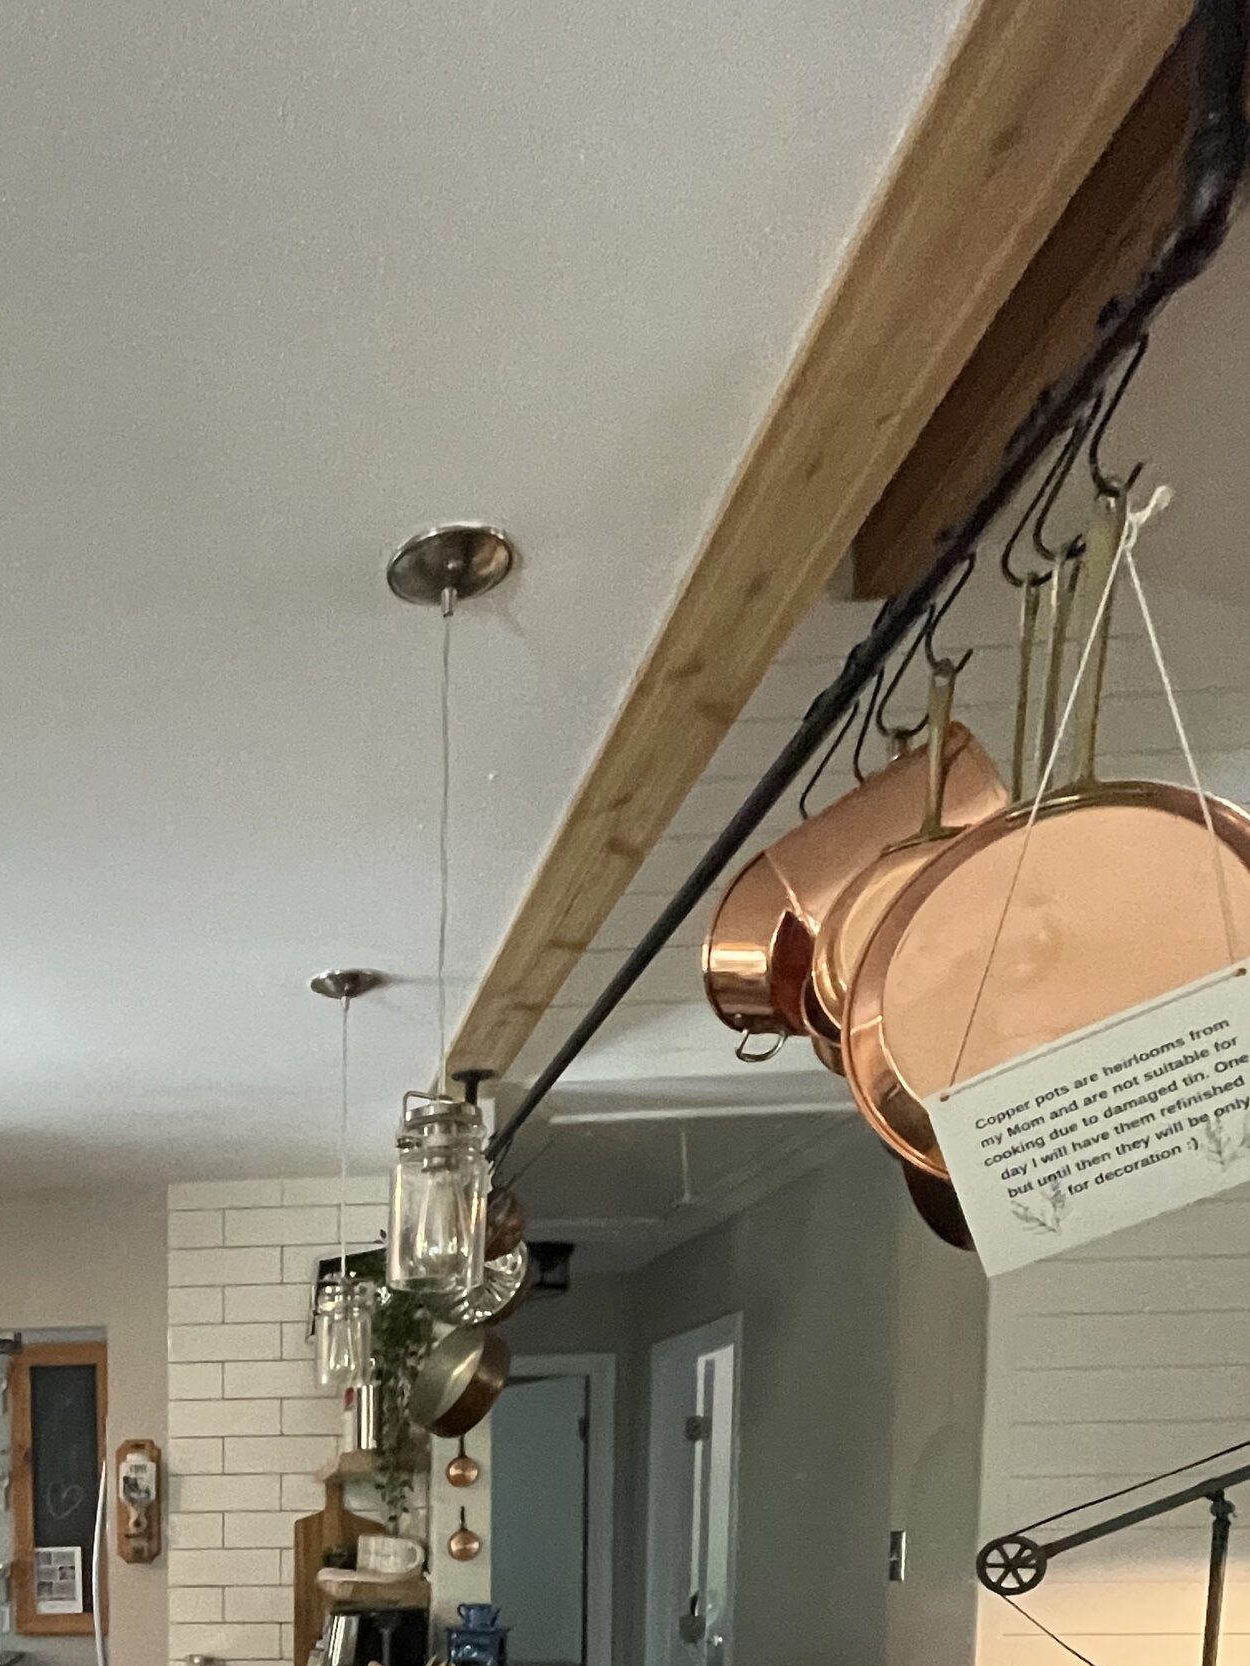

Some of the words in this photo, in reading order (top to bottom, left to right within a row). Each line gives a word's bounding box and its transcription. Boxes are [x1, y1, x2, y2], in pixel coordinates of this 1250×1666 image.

[975, 1100, 1030, 1129] Copper
[1035, 1085, 1069, 1107] pots
[1074, 1073, 1099, 1089] are
[1102, 1038, 1185, 1076] heirlooms
[1189, 1020, 1229, 1040] from
[981, 1133, 1002, 1148] my
[1007, 1116, 1045, 1137] Mom
[1050, 1100, 1079, 1120] and
[1083, 1090, 1108, 1106] are
[1112, 1076, 1139, 1094] not
[1144, 1049, 1210, 1082] suitable
[1214, 1037, 1237, 1052] for
[984, 1136, 1046, 1167] cooking
[1049, 1123, 1078, 1140] due
[1082, 1115, 1099, 1127] to
[1103, 1080, 1178, 1119] damaged
[1182, 1072, 1210, 1087] tin.
[1214, 1054, 1249, 1073] One
[1001, 1163, 1027, 1180] day
[1040, 1145, 1068, 1163] will
[1072, 1131, 1110, 1152] have
[1114, 1113, 1156, 1135] them
[1160, 1075, 1245, 1117] refinished
[1007, 1181, 1034, 1198] but
[1037, 1164, 1071, 1187] until
[1075, 1152, 1111, 1171] then
[1115, 1136, 1150, 1155] they
[1155, 1120, 1184, 1140] will
[1188, 1113, 1209, 1127] be
[1214, 1096, 1250, 1117] only
[1068, 1180, 1090, 1195] for
[1094, 1145, 1182, 1185] decoration
